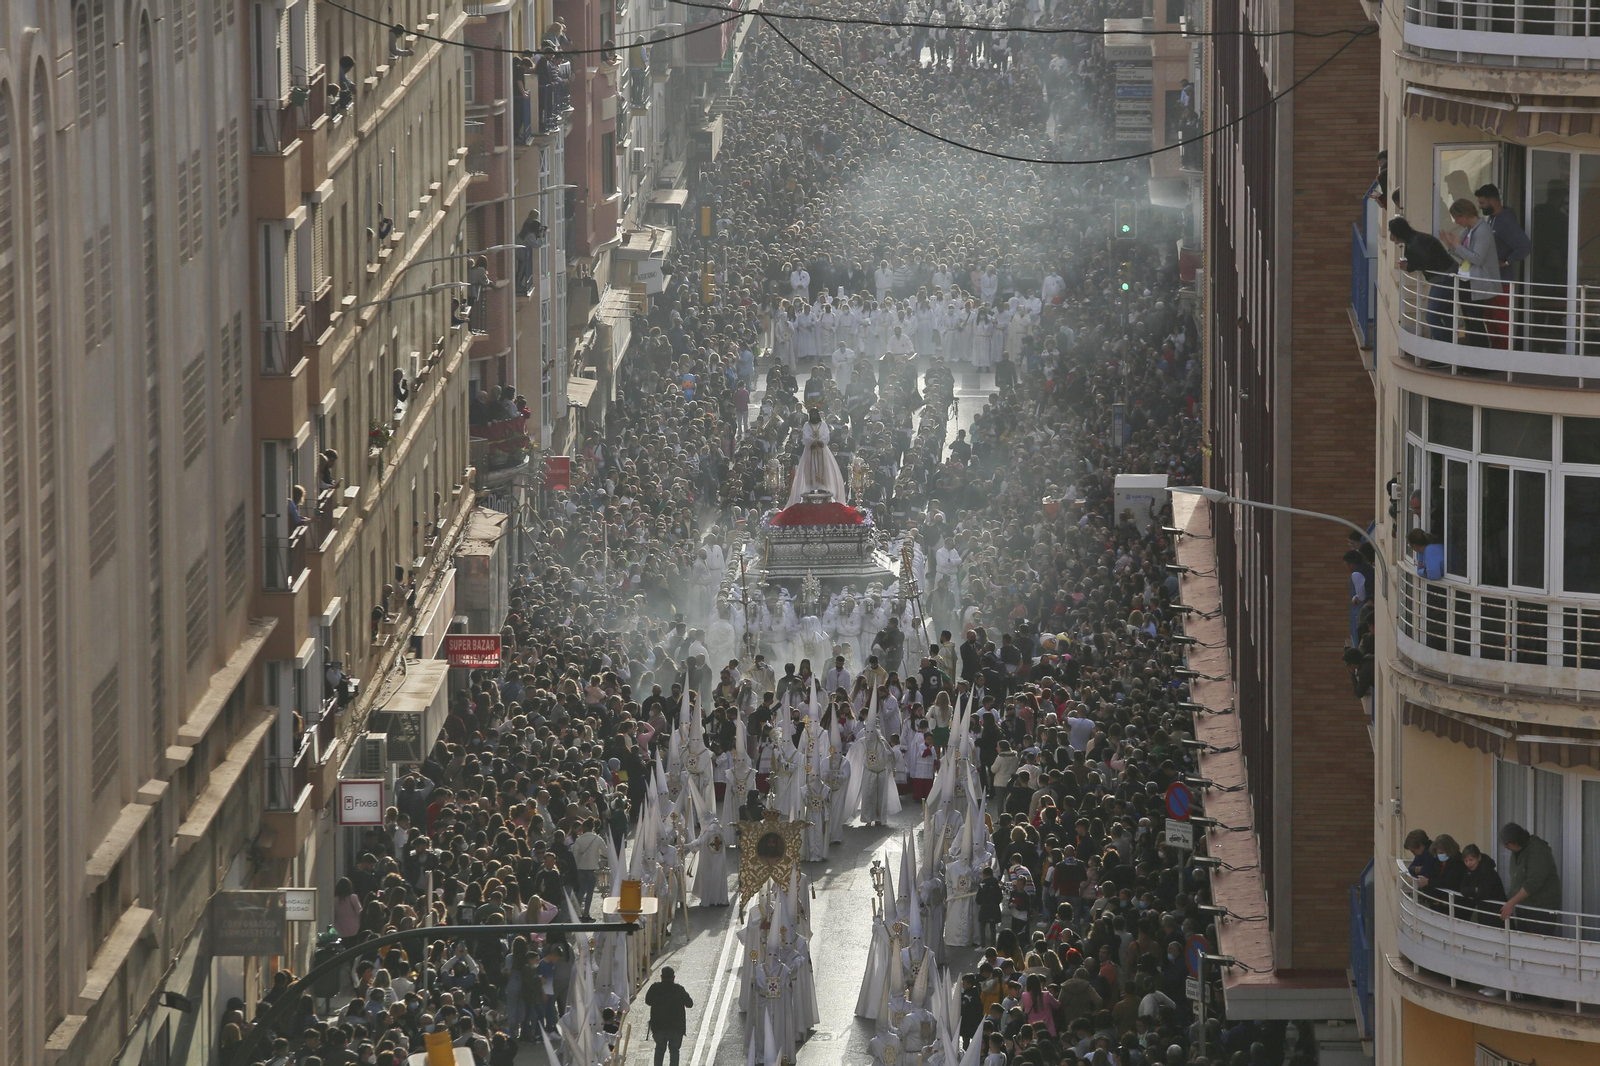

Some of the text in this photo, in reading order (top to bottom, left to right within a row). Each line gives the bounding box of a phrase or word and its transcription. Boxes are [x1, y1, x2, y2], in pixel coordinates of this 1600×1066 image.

[449, 639, 495, 650] SUPER BAZAR
[354, 798, 378, 807] Fixea
